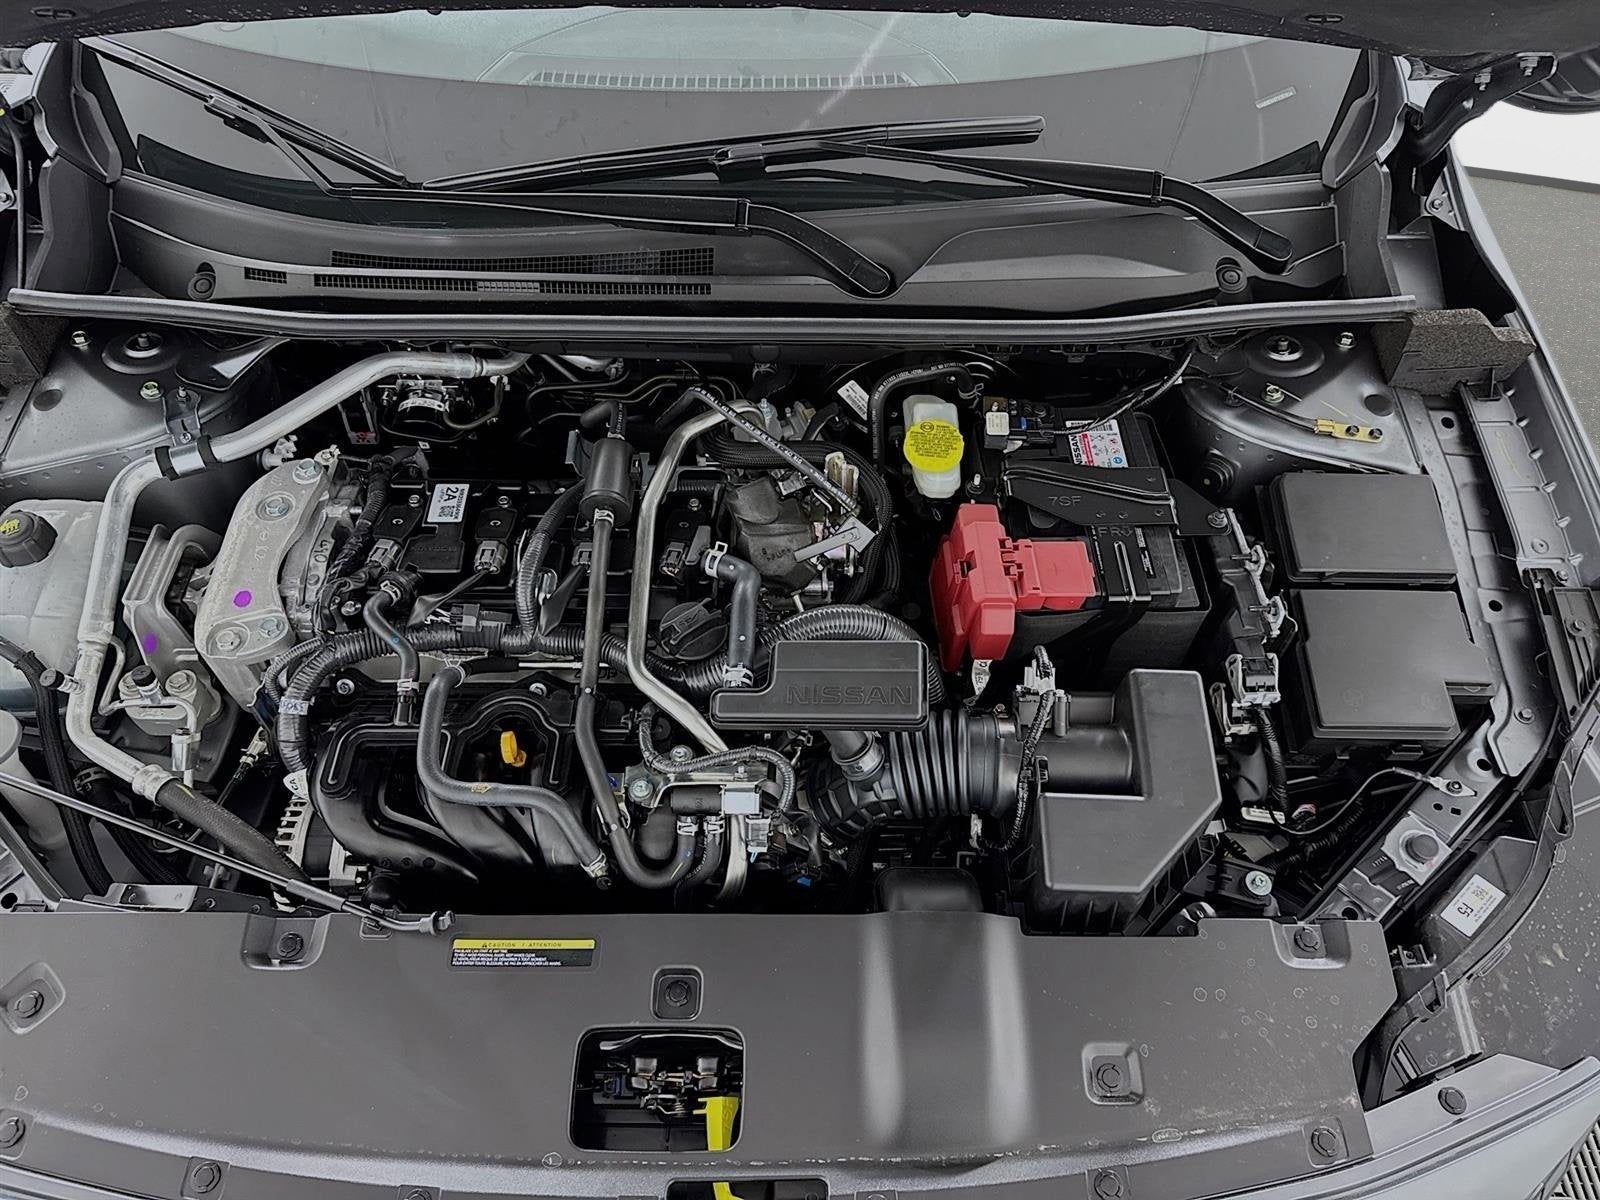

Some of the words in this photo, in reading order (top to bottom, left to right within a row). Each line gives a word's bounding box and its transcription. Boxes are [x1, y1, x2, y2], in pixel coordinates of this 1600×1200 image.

[1071, 435, 1083, 465] NISSAN
[444, 487, 459, 502] 2A
[1048, 495, 1082, 506] 7SF
[786, 684, 913, 705] NISSAN
[1457, 902, 1474, 918] F5
